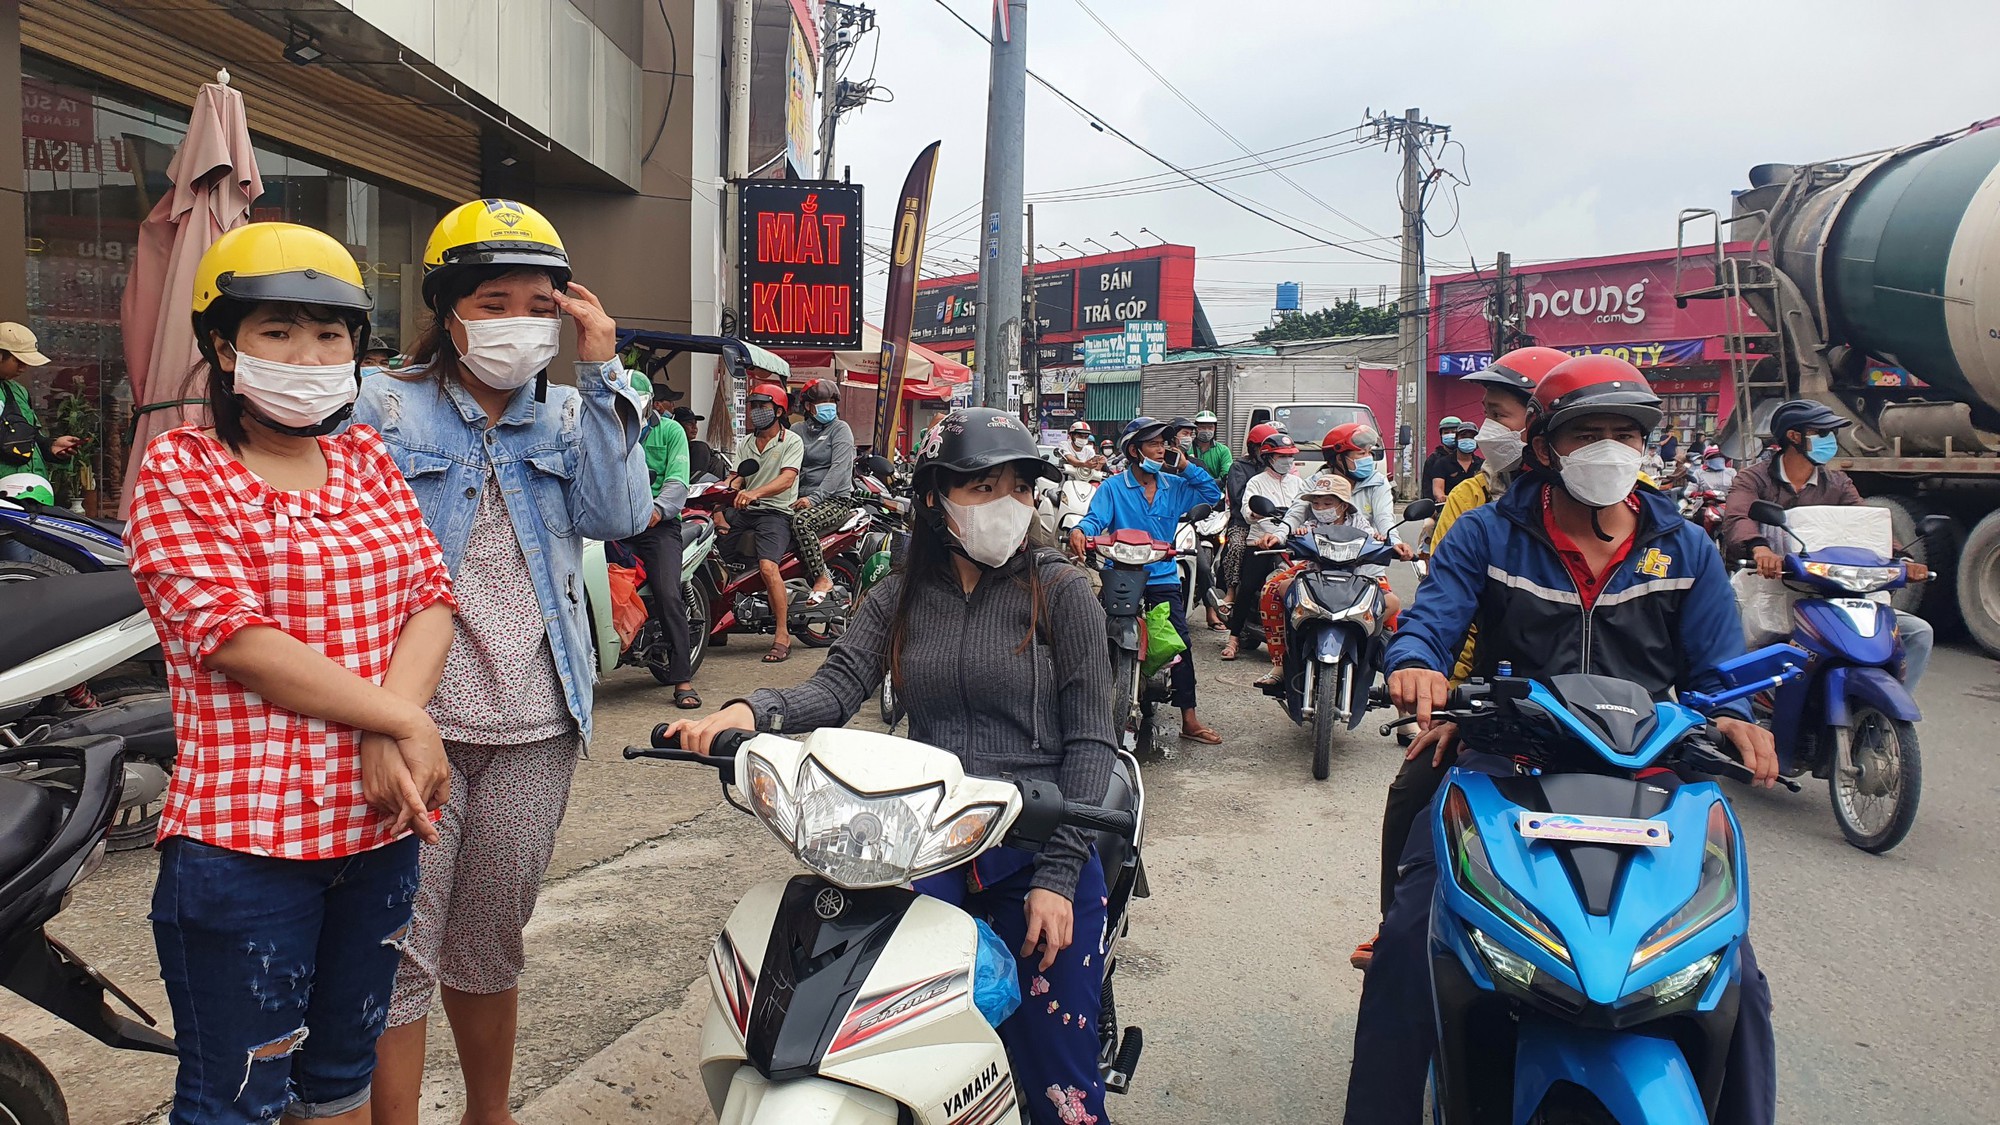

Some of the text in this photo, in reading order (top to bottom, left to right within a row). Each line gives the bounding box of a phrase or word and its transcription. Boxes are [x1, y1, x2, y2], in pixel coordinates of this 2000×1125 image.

[758, 193, 845, 265] MẮT
[1100, 267, 1132, 291] BÁN
[753, 272, 849, 334] KÍNH
[1084, 296, 1147, 323] TRẢ GÓP
[1127, 332, 1165, 342] NAIL PHUN
[1127, 354, 1142, 365] SPA
[1459, 354, 1476, 371] TÃ
[1631, 342, 1665, 367] TỶ
[869, 564, 885, 582] Grab
[1594, 703, 1638, 716] HONDA
[857, 982, 951, 1031] SIRIUS
[943, 1061, 999, 1118] YAMAHA
